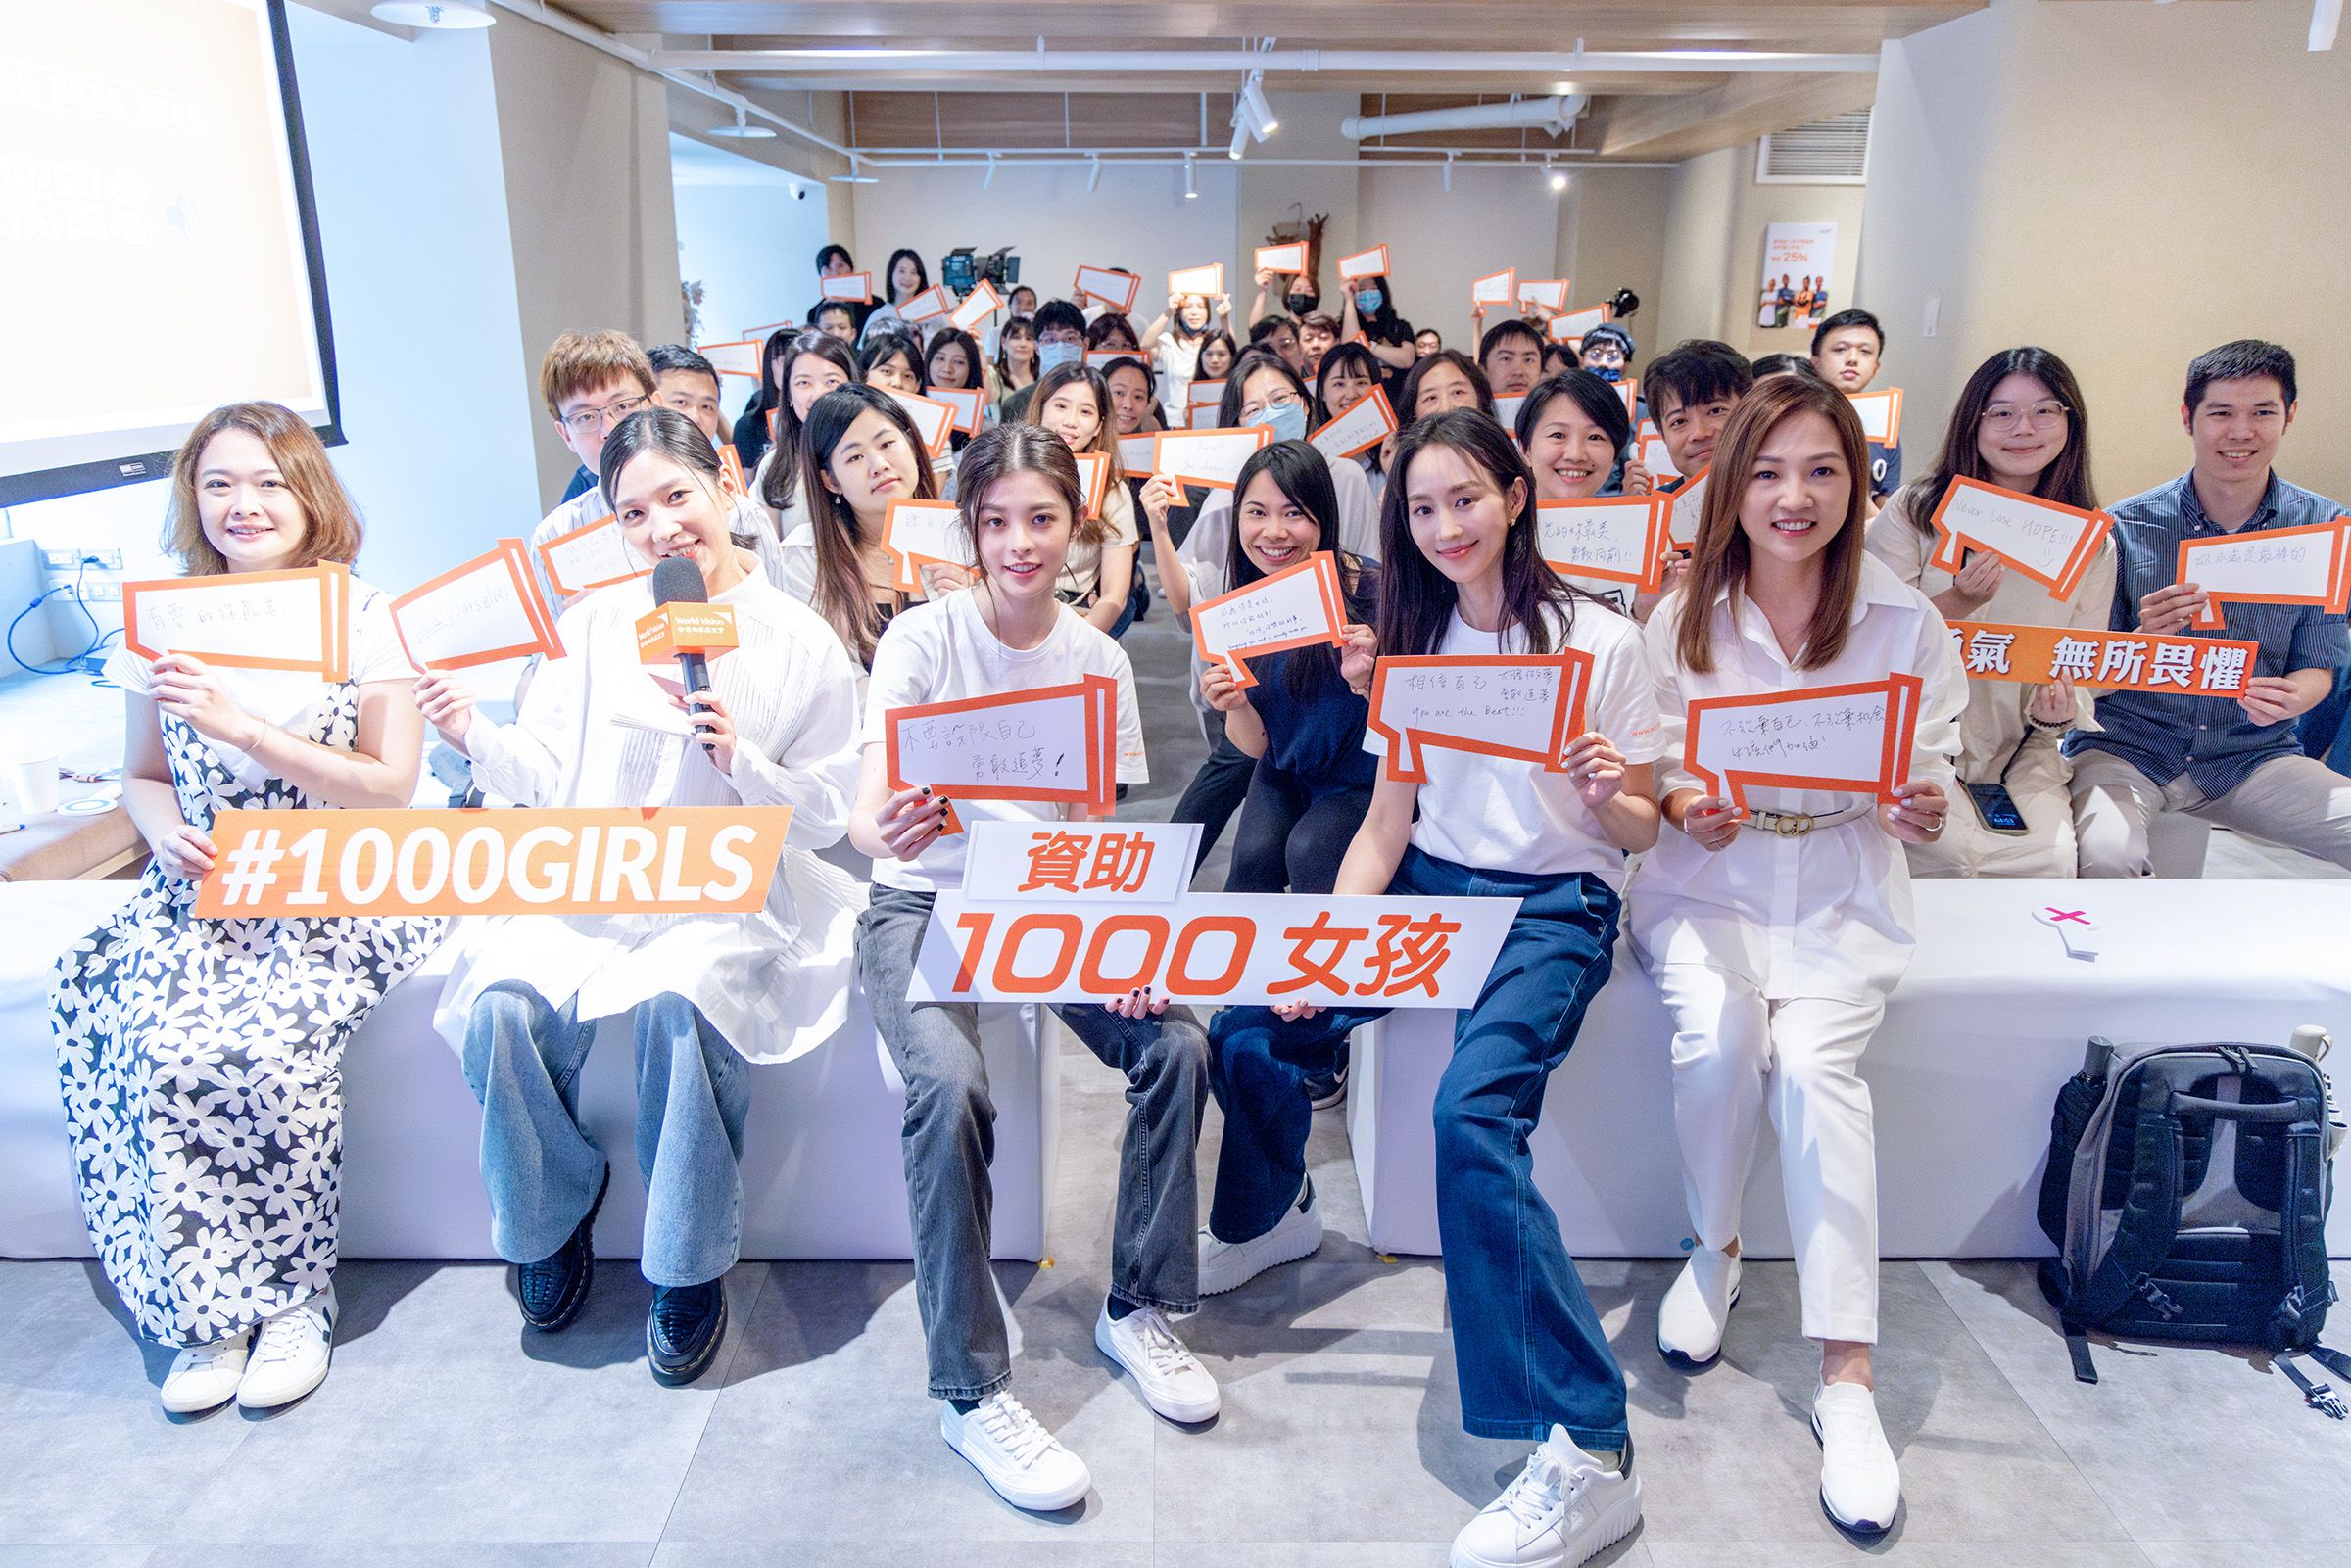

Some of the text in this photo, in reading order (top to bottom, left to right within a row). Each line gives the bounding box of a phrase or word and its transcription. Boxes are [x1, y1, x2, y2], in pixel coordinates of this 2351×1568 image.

[675, 616, 725, 626] World Vision
[2048, 635, 2249, 691] 無所畏懼
[1458, 707, 1477, 717] the
[221, 824, 758, 906] #1000GIRLS
[1017, 830, 1156, 894] 資助
[951, 911, 1462, 999] 1000 女孩
